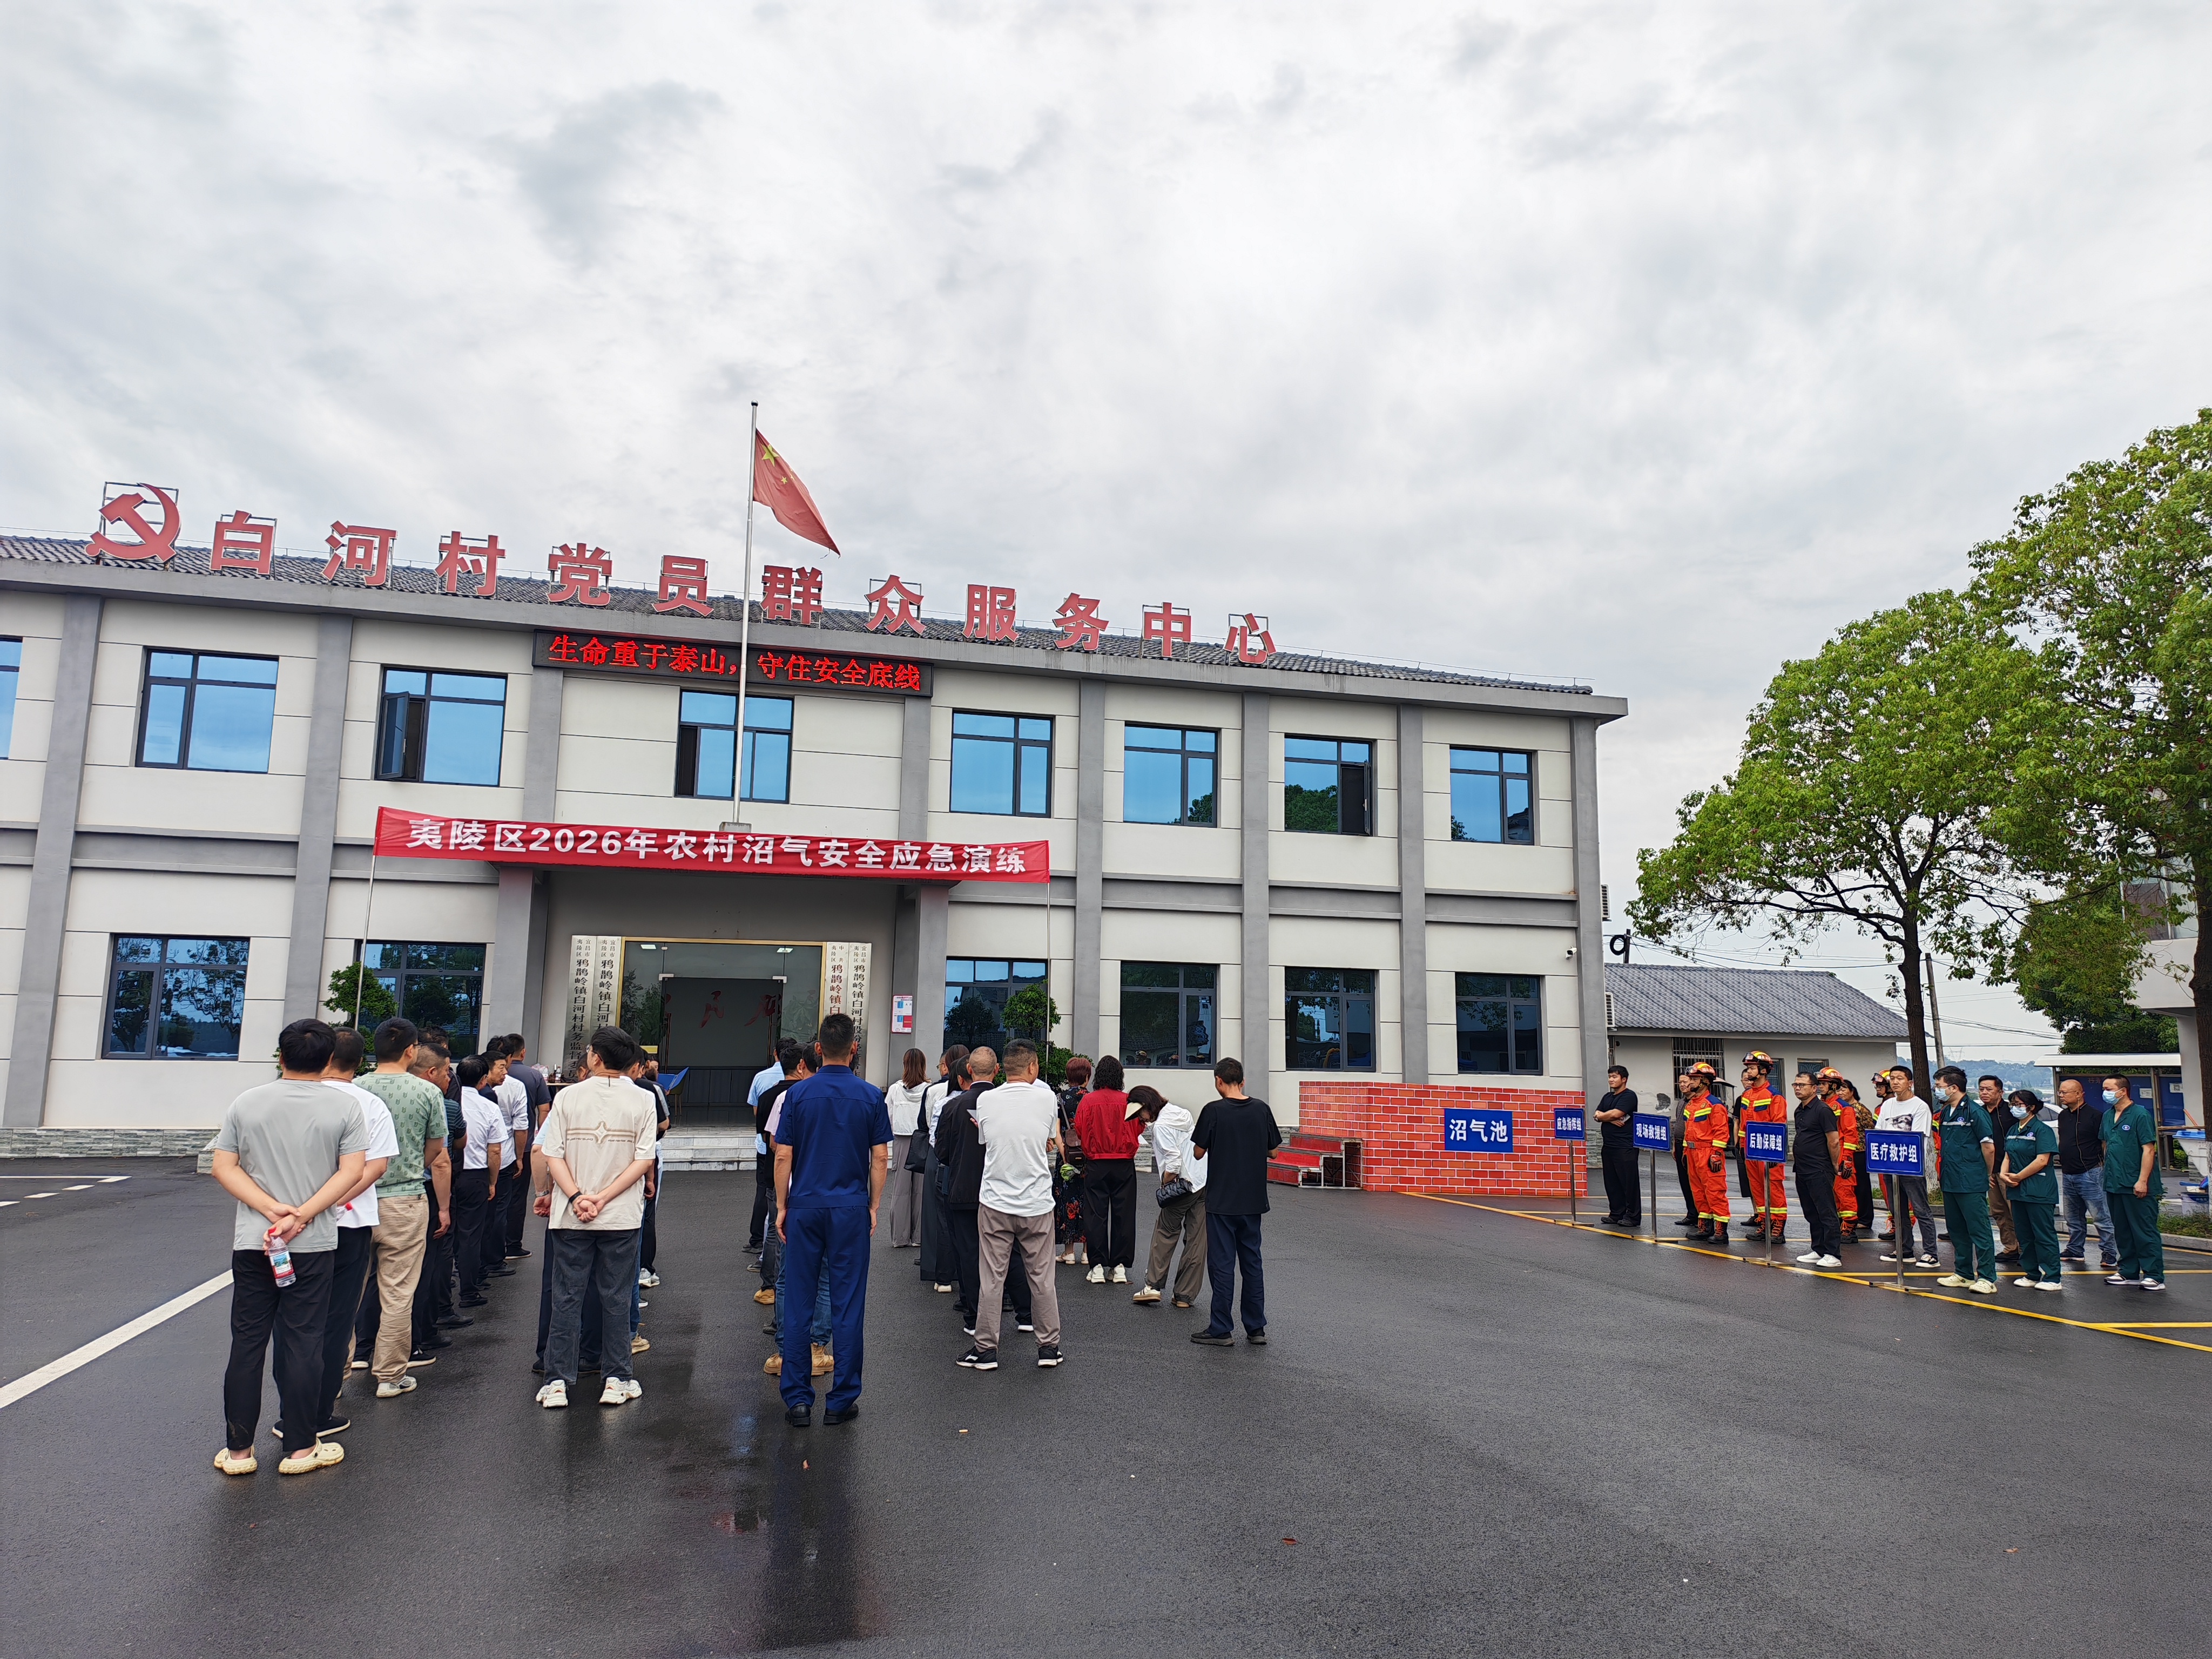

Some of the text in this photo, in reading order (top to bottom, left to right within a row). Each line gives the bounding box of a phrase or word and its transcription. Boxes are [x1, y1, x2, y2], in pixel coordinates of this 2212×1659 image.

[210, 510, 1276, 665] 白河村党员群众服务中心
[548, 634, 920, 691] 生命重于泰山，守住安全底线
[406, 818, 1026, 874] 夷陵区2026年农村沼气安全应急演练
[1449, 1118, 1508, 1143] 沼气池
[1556, 1116, 1582, 1131] 应急指挥组
[1636, 1123, 1667, 1141] 现场救援组
[1749, 1132, 1782, 1151] 后勤保障组
[1870, 1142, 1918, 1163] 医疗救护组
